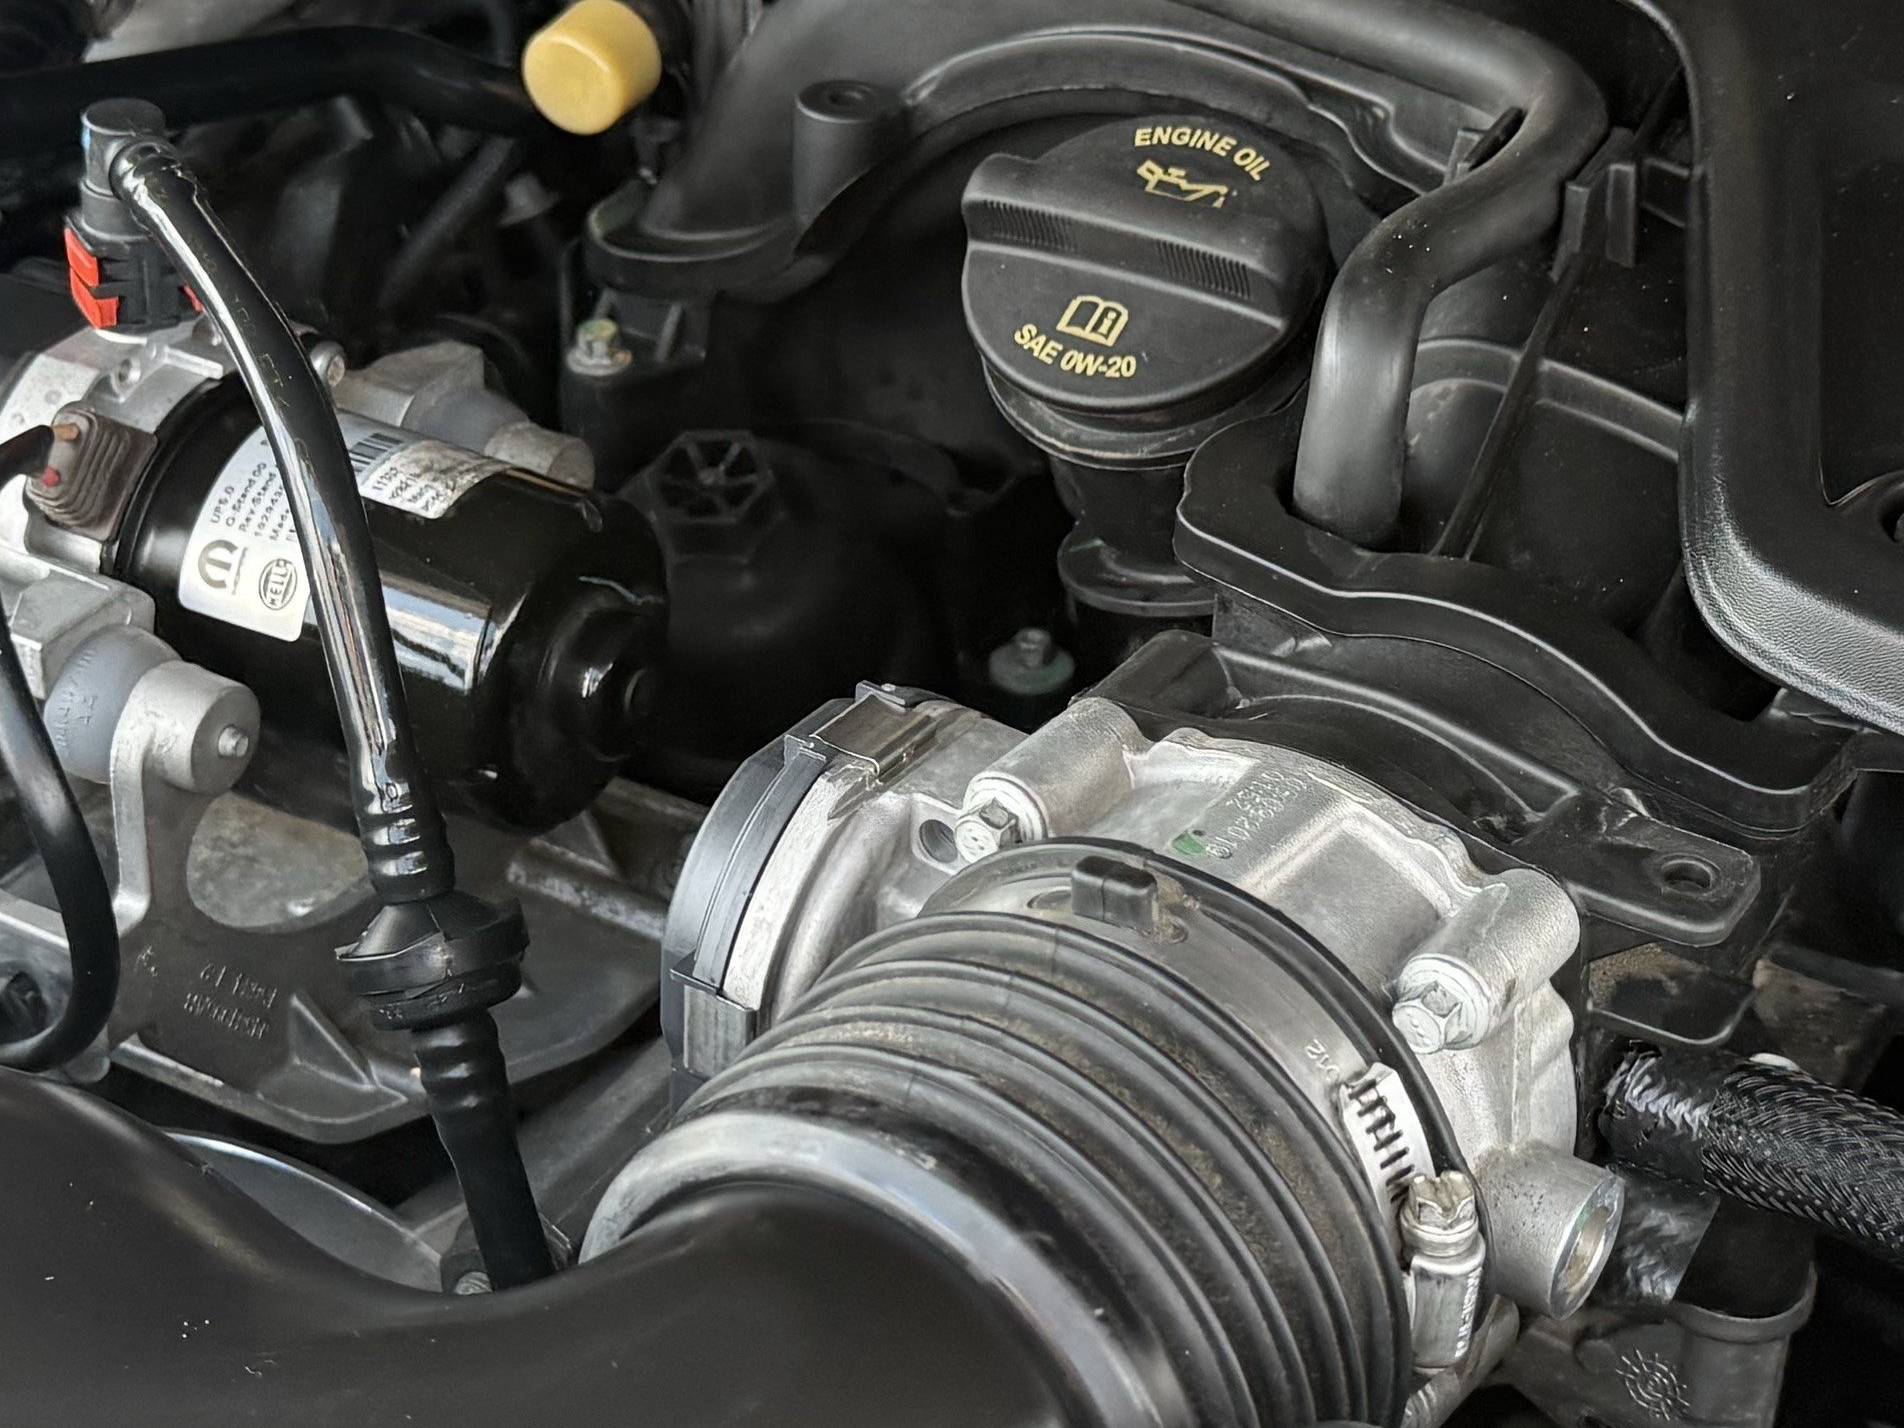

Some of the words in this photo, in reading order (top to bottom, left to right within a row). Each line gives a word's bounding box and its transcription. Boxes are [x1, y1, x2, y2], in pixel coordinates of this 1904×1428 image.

[1134, 126, 1238, 158] ENGINE
[1233, 147, 1271, 182] OIL
[1013, 323, 1063, 365] SAE
[1060, 348, 1137, 378] 0W-20
